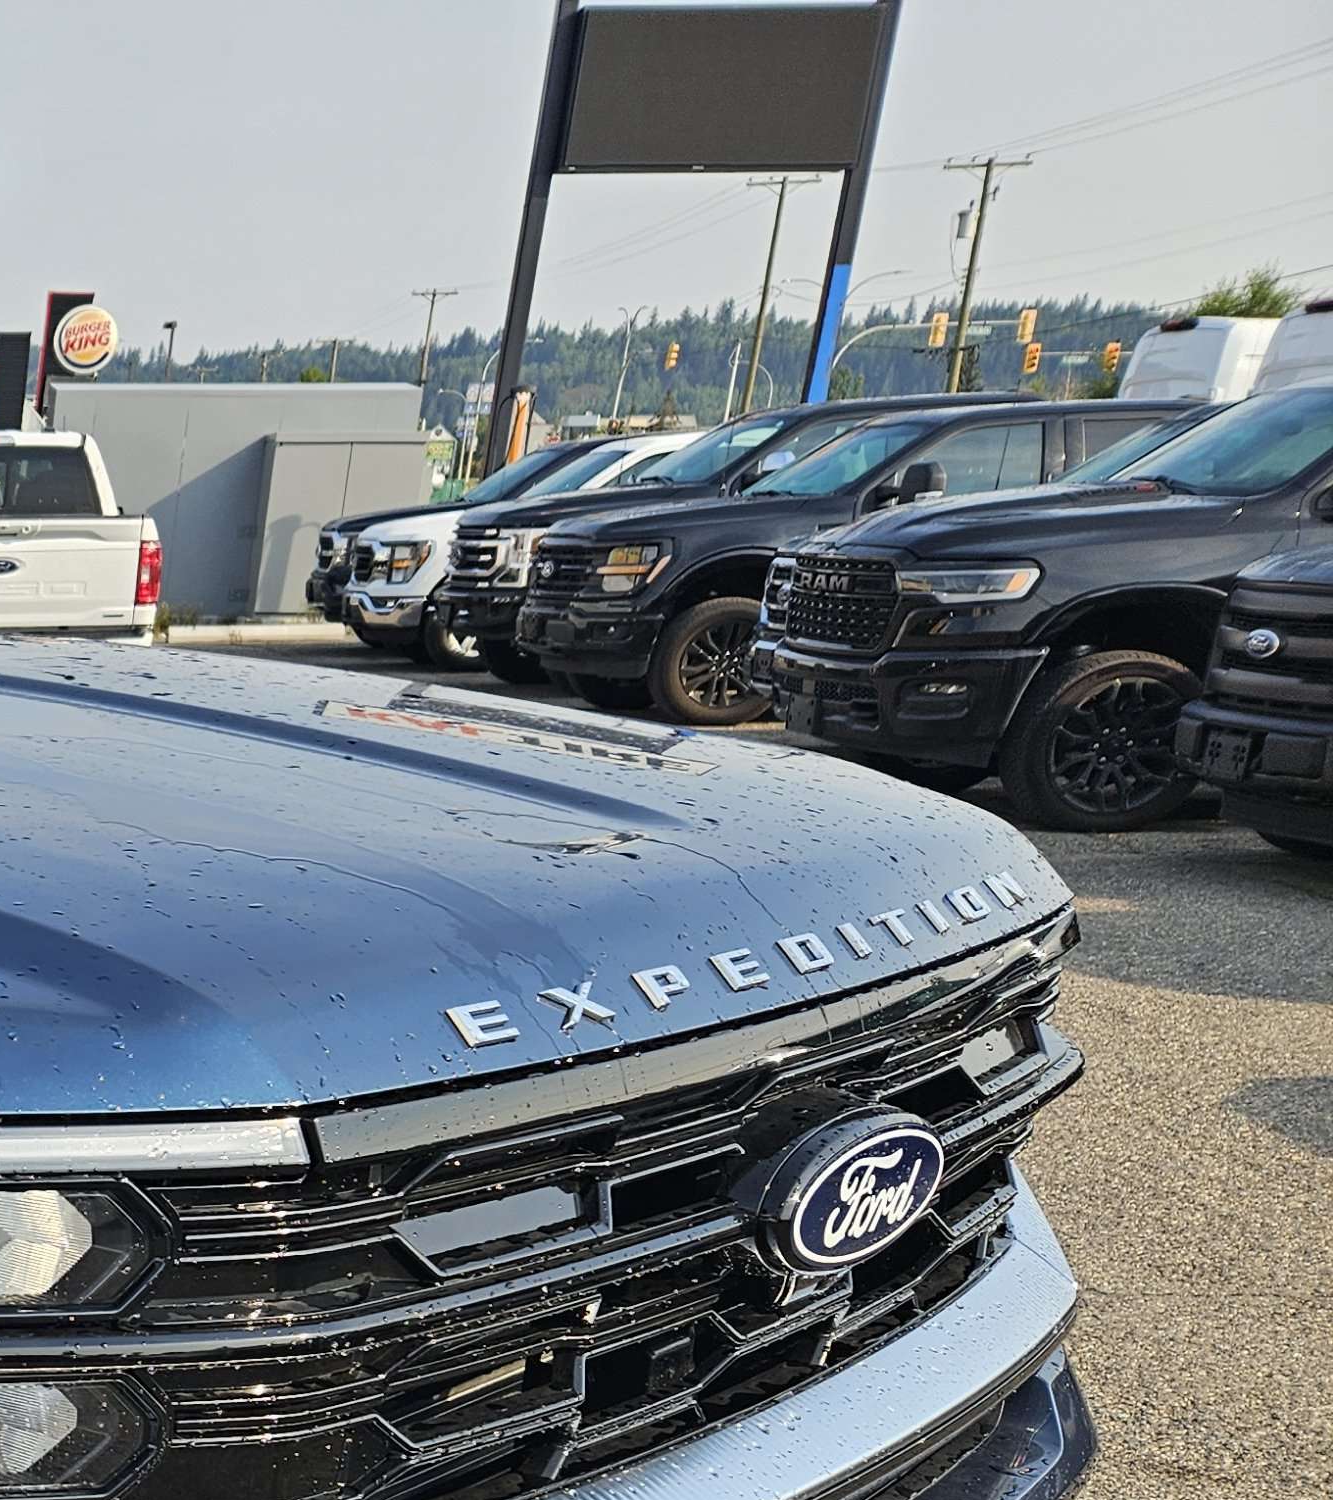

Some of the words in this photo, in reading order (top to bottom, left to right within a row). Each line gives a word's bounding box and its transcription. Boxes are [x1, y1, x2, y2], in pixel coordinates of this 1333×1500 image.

[64, 320, 111, 339] BURGER
[64, 332, 110, 354] KING
[799, 572, 850, 592] RAM
[445, 871, 1029, 1048] EXPEDITION
[823, 1147, 923, 1249] Ford
